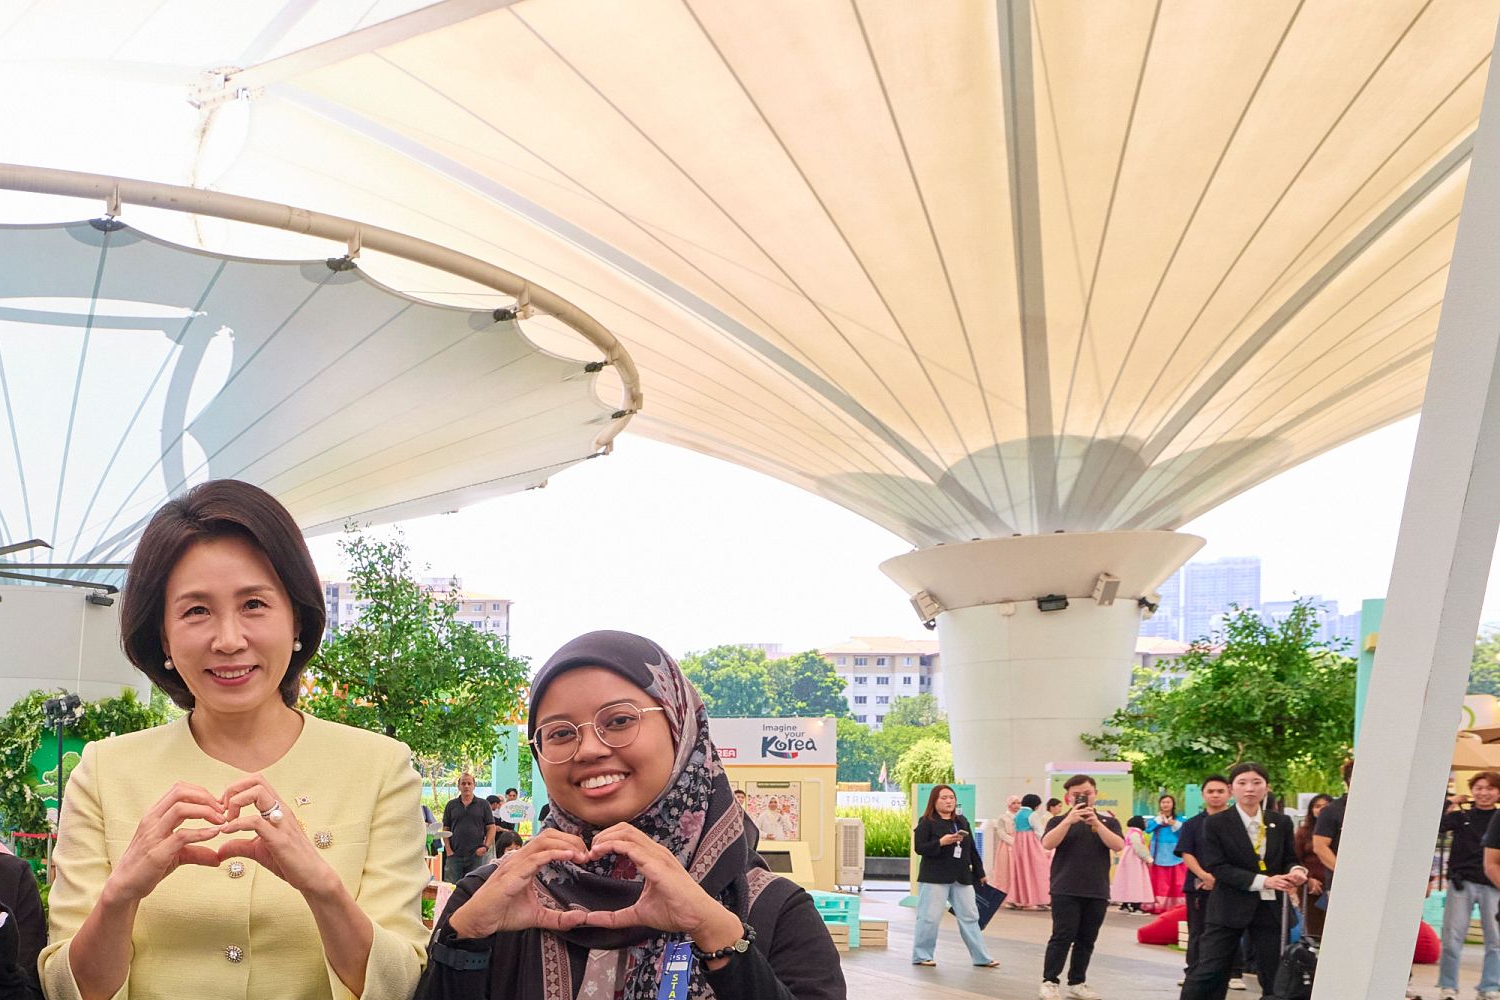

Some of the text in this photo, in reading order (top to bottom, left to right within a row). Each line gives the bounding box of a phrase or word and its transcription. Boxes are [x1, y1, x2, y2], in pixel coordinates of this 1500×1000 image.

[762, 724, 797, 732] Imagine
[784, 730, 805, 739] your
[762, 735, 817, 758] Korea
